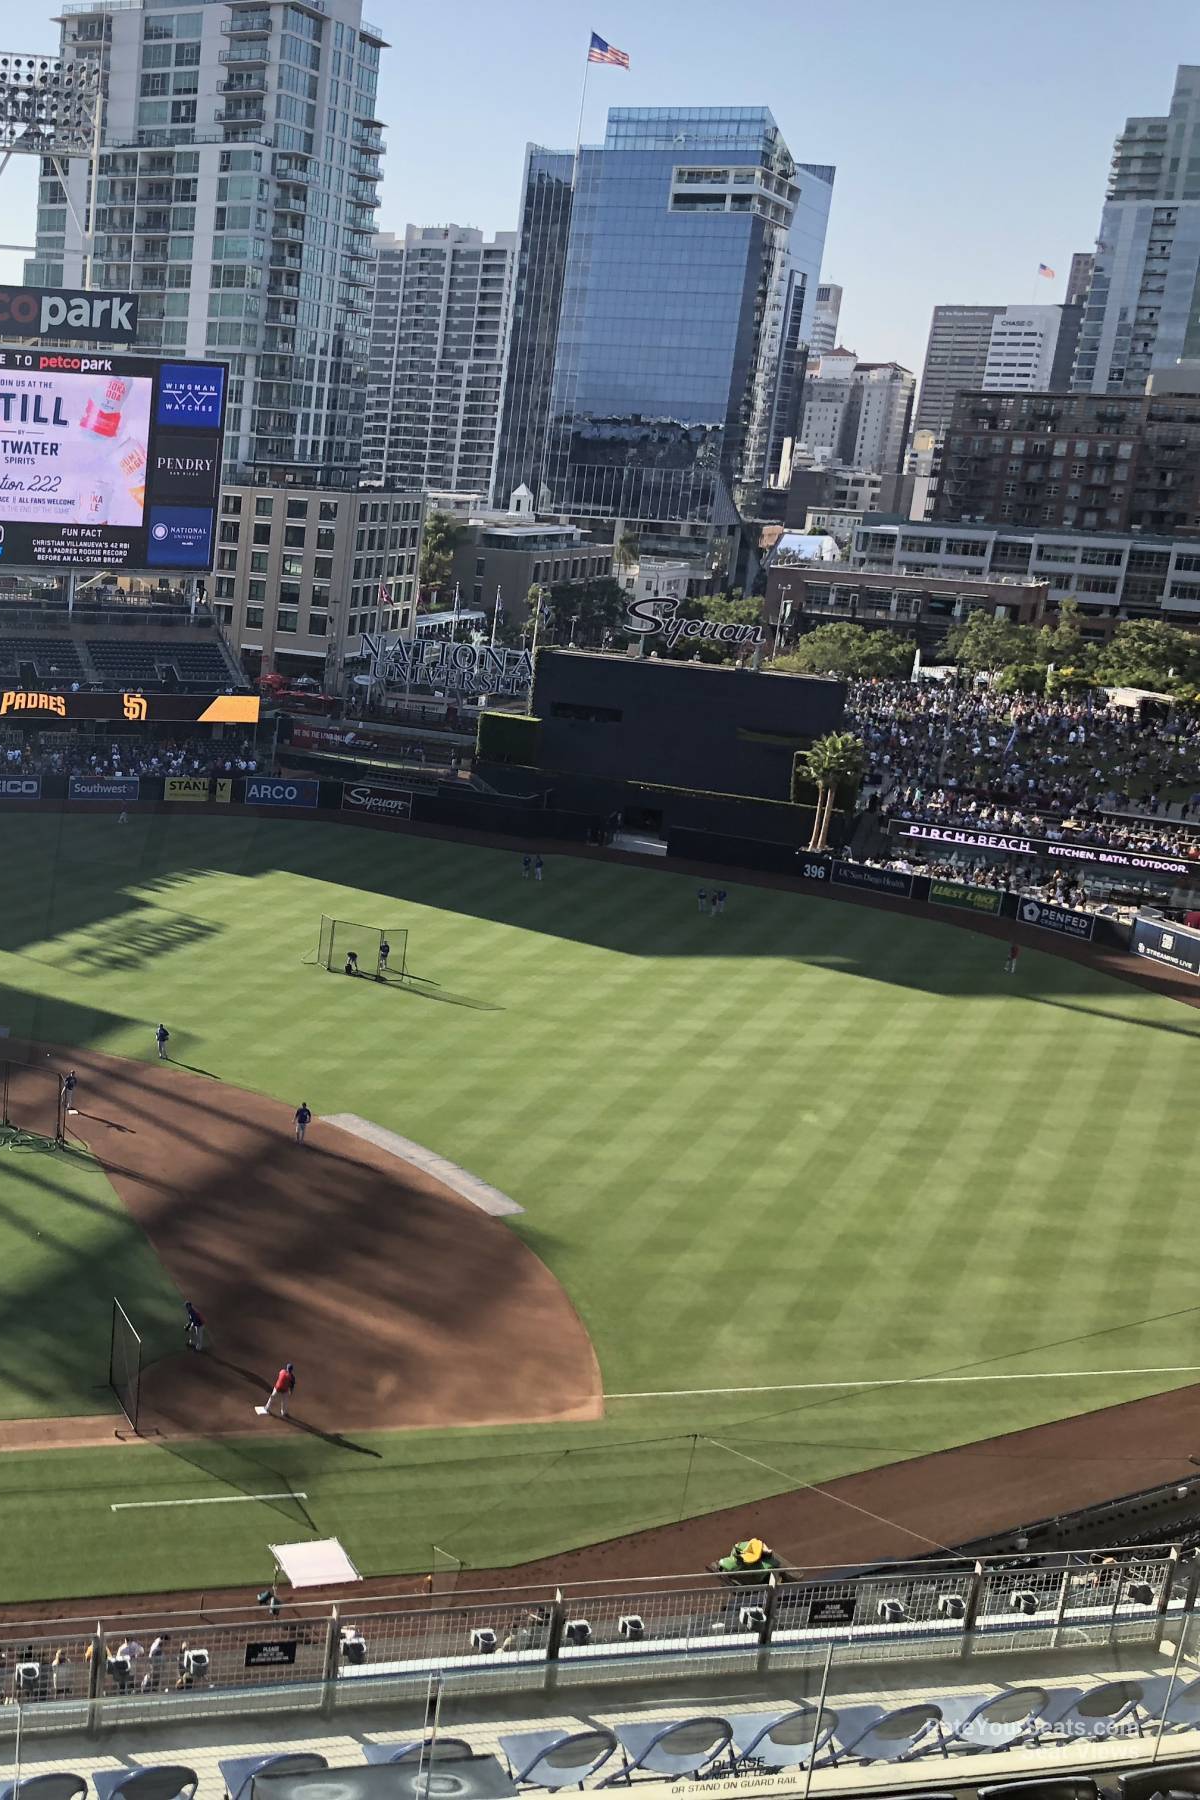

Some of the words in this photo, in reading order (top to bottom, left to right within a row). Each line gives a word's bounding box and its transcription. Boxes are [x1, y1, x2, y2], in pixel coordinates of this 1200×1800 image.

[16, 354, 32, 366] TO
[40, 355, 112, 372] petcopark
[16, 380, 25, 388] US
[40, 381, 52, 389] THE
[166, 383, 215, 392] WINGMAN
[166, 403, 213, 412] WATCHES
[4, 457, 36, 465] SPIRITS
[157, 457, 213, 471] PENDRY
[27, 475, 62, 492] 222
[19, 496, 29, 504] ALL
[47, 498, 75, 506] WELCOME
[61, 528, 78, 536] FUN
[80, 529, 102, 537] FACT
[171, 527, 207, 535] NATIONAL
[624, 597, 766, 648] Sycuan
[359, 632, 533, 677] NATIONA
[0, 692, 66, 717] PADRES
[74, 783, 127, 794] Southwest
[169, 780, 226, 791] STANLY
[248, 785, 297, 800] ARCO
[345, 788, 410, 810] Sycuan
[910, 825, 966, 843] PIRCH
[978, 835, 1030, 852] BEACH
[1049, 846, 1096, 860] KITCHEN.
[1099, 853, 1130, 866] BATH.
[1132, 858, 1189, 873] OUTDOOR.
[803, 864, 825, 879] 396
[1042, 909, 1088, 929] PENFED
[1146, 948, 1179, 964] STREAMING
[1179, 959, 1193, 969] LIVE
[687, 1783, 721, 1793] STAND
[723, 1781, 738, 1789] ON
[740, 1778, 775, 1788] GUARD
[777, 1776, 798, 1784] RAIL
